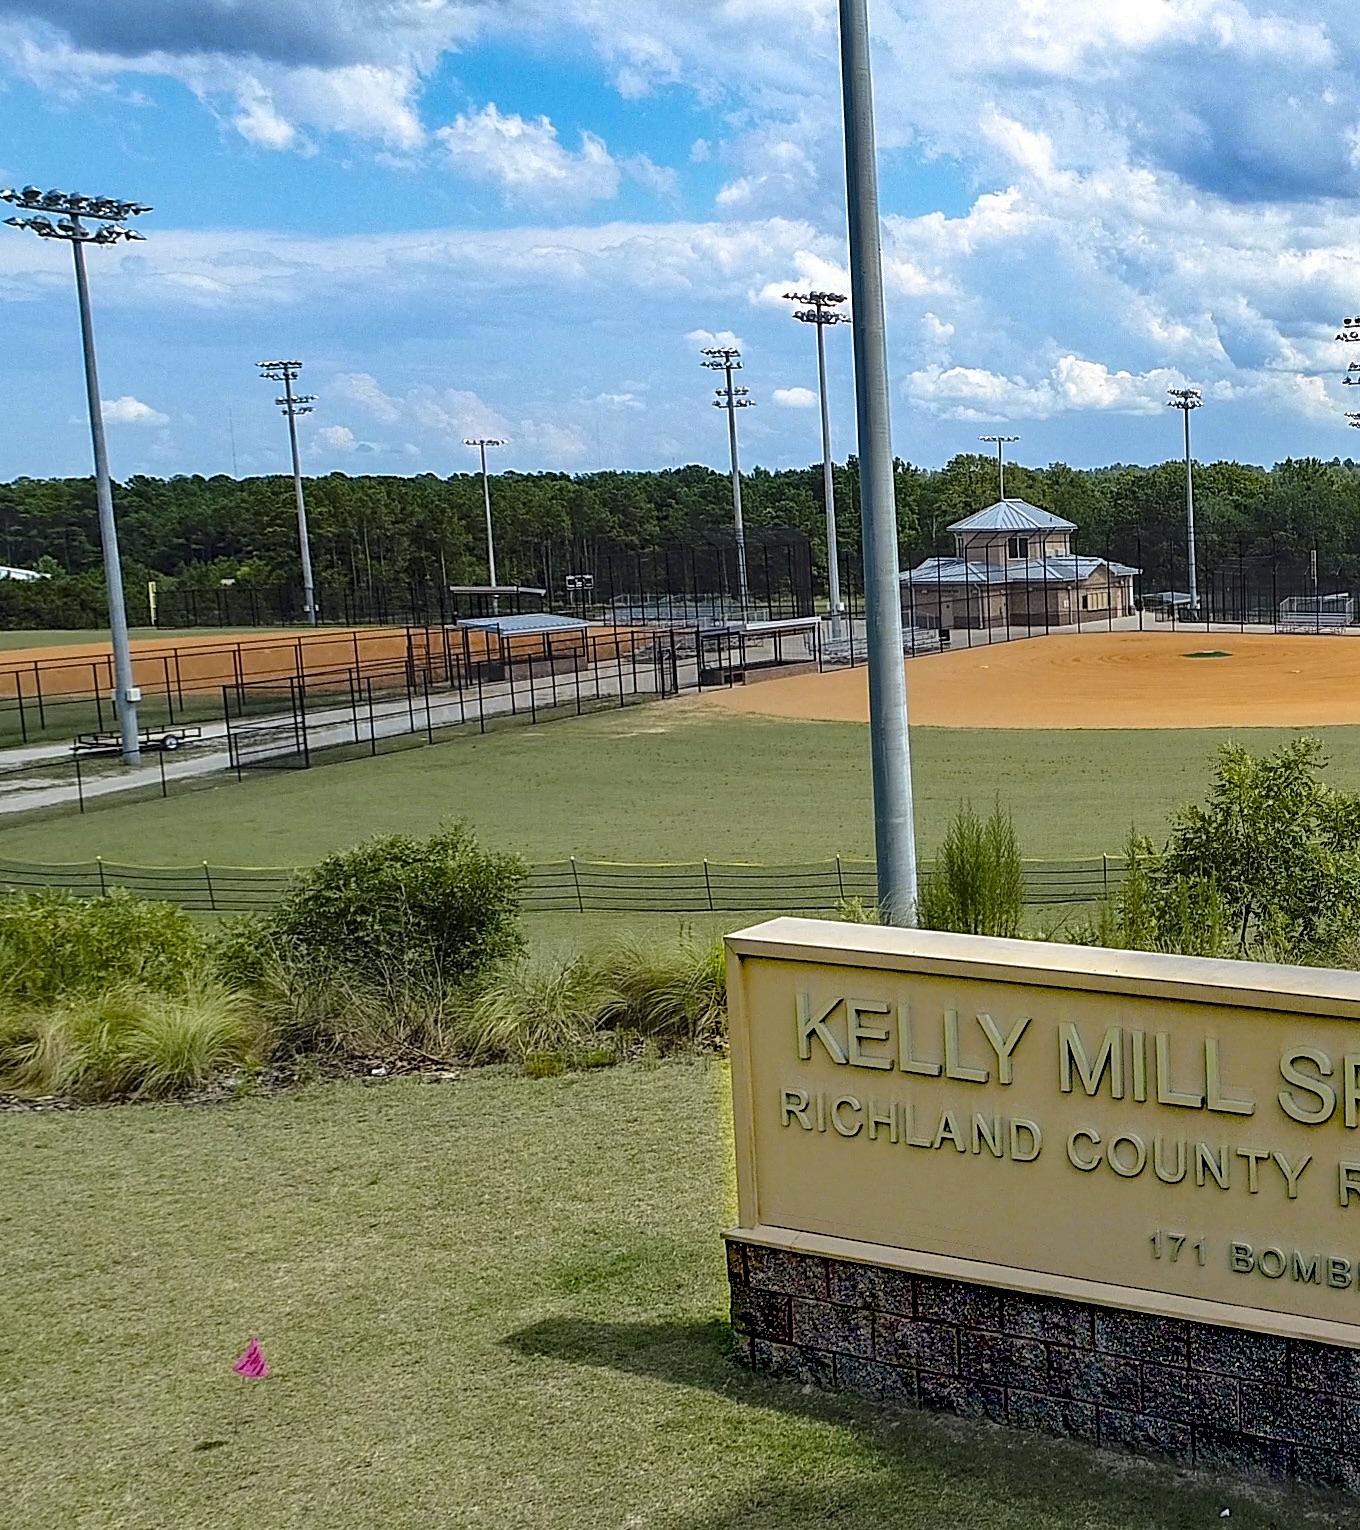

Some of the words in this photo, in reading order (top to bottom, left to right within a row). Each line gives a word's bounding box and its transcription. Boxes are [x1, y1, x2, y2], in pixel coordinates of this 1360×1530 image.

[797, 993, 1032, 1085] KELLY
[1058, 1021, 1255, 1115] MILL
[780, 1086, 1043, 1162] RICHLAND
[1067, 1127, 1311, 1199] COUNTY
[1150, 1230, 1206, 1267] 171
